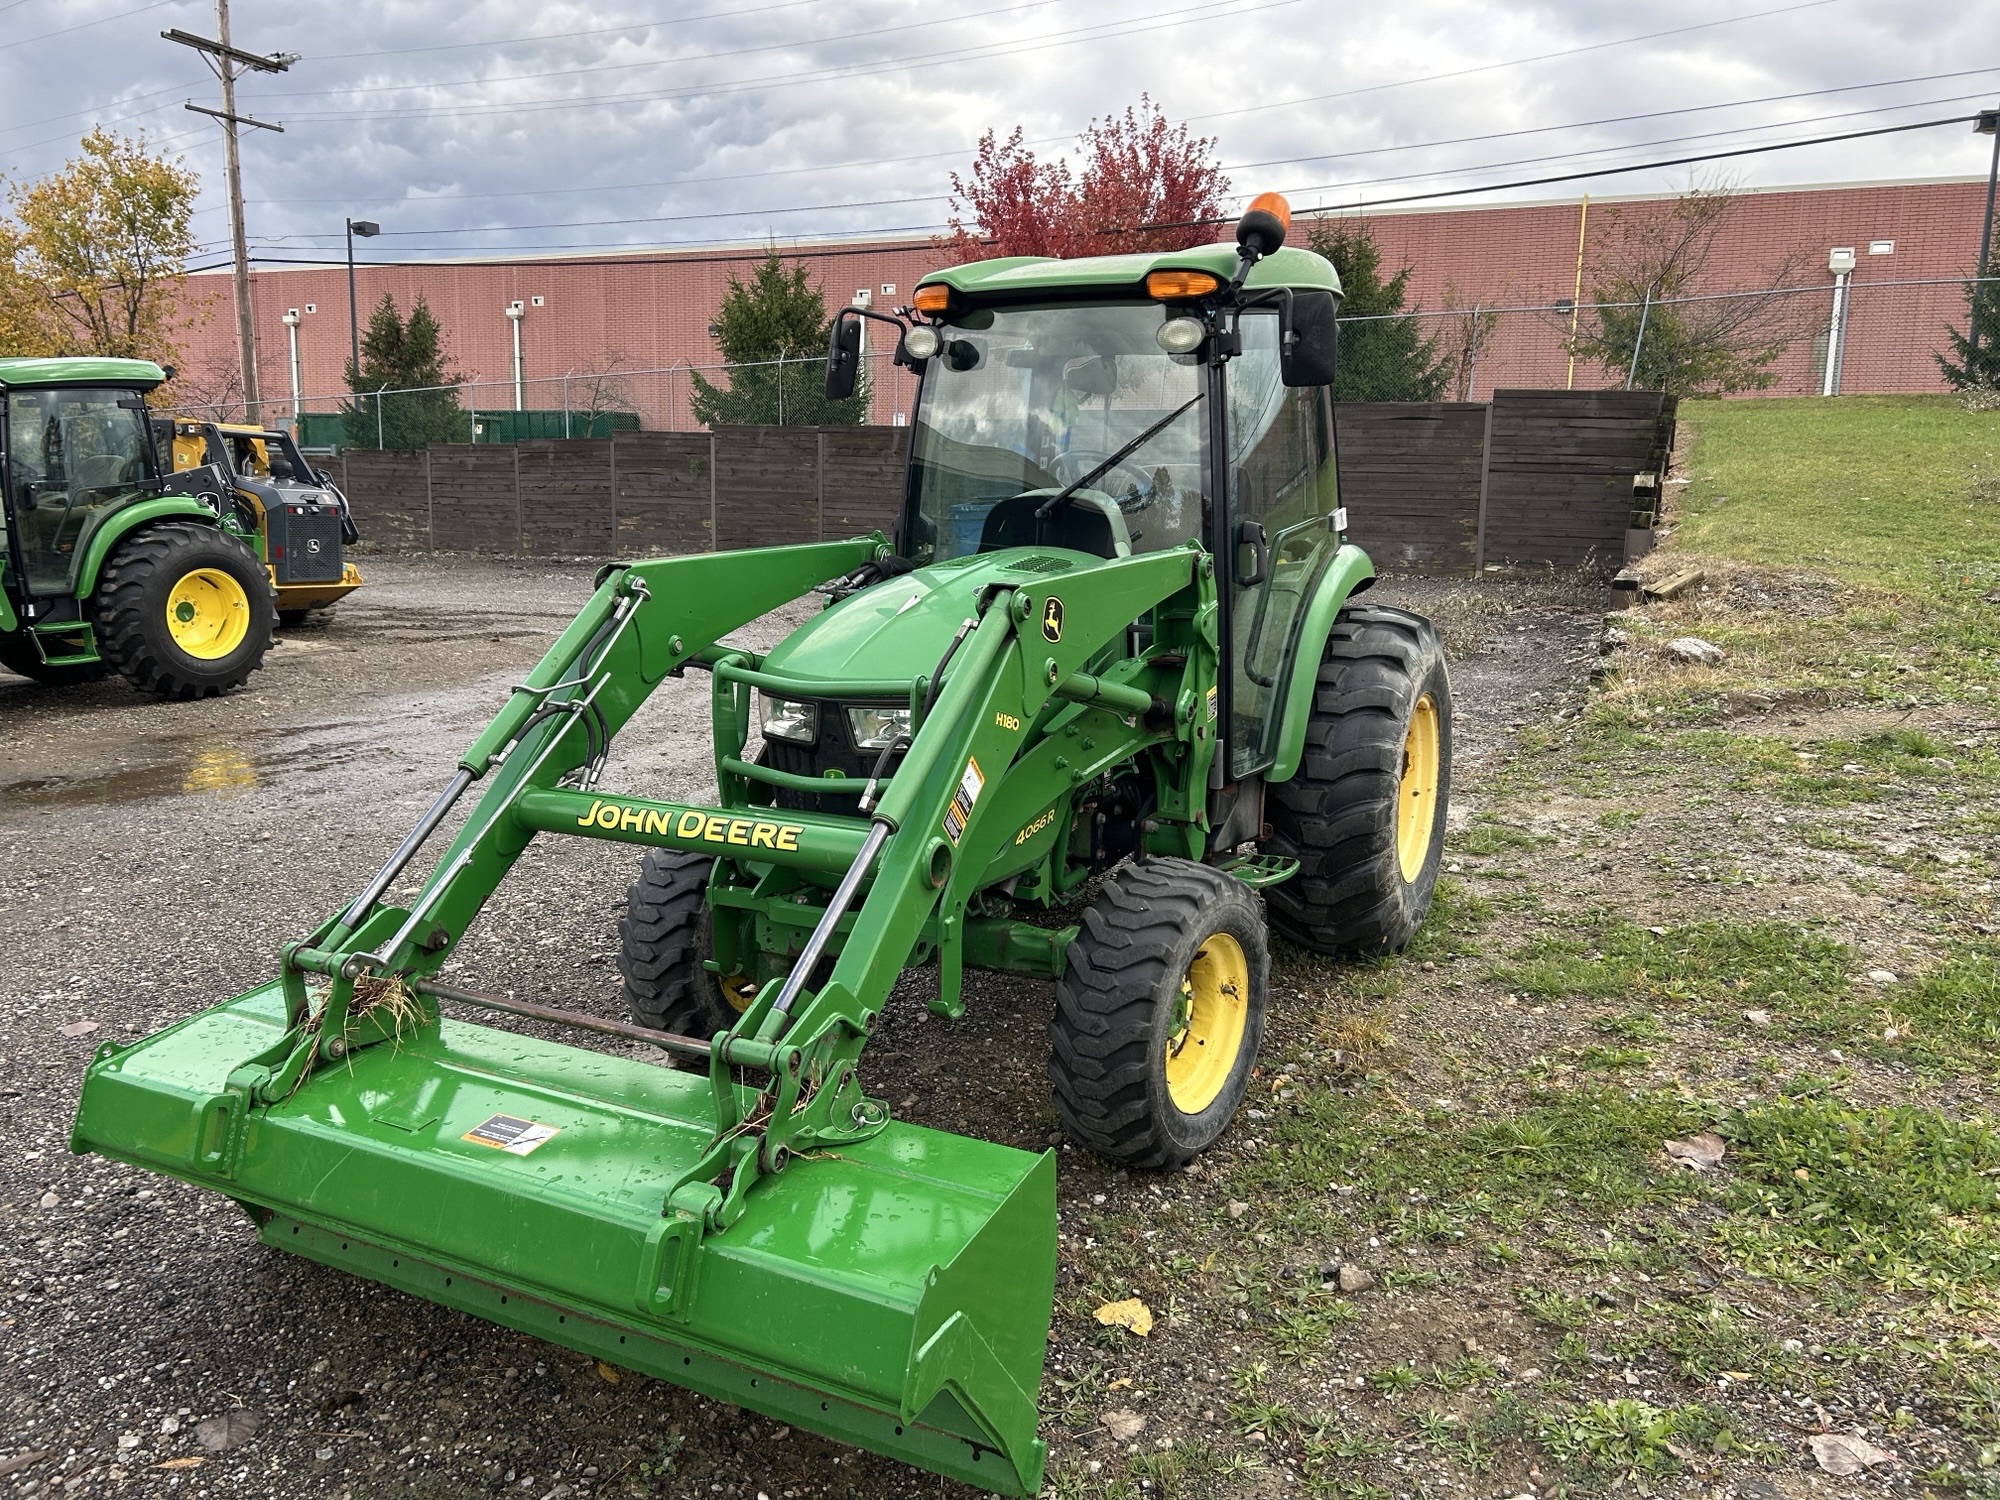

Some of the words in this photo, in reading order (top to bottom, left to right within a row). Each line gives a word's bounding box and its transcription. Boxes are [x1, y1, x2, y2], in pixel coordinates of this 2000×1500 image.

[995, 711, 1020, 731] H180
[577, 800, 671, 836] JOHN
[676, 810, 804, 851] DEERE
[1015, 808, 1056, 846] 4066R
